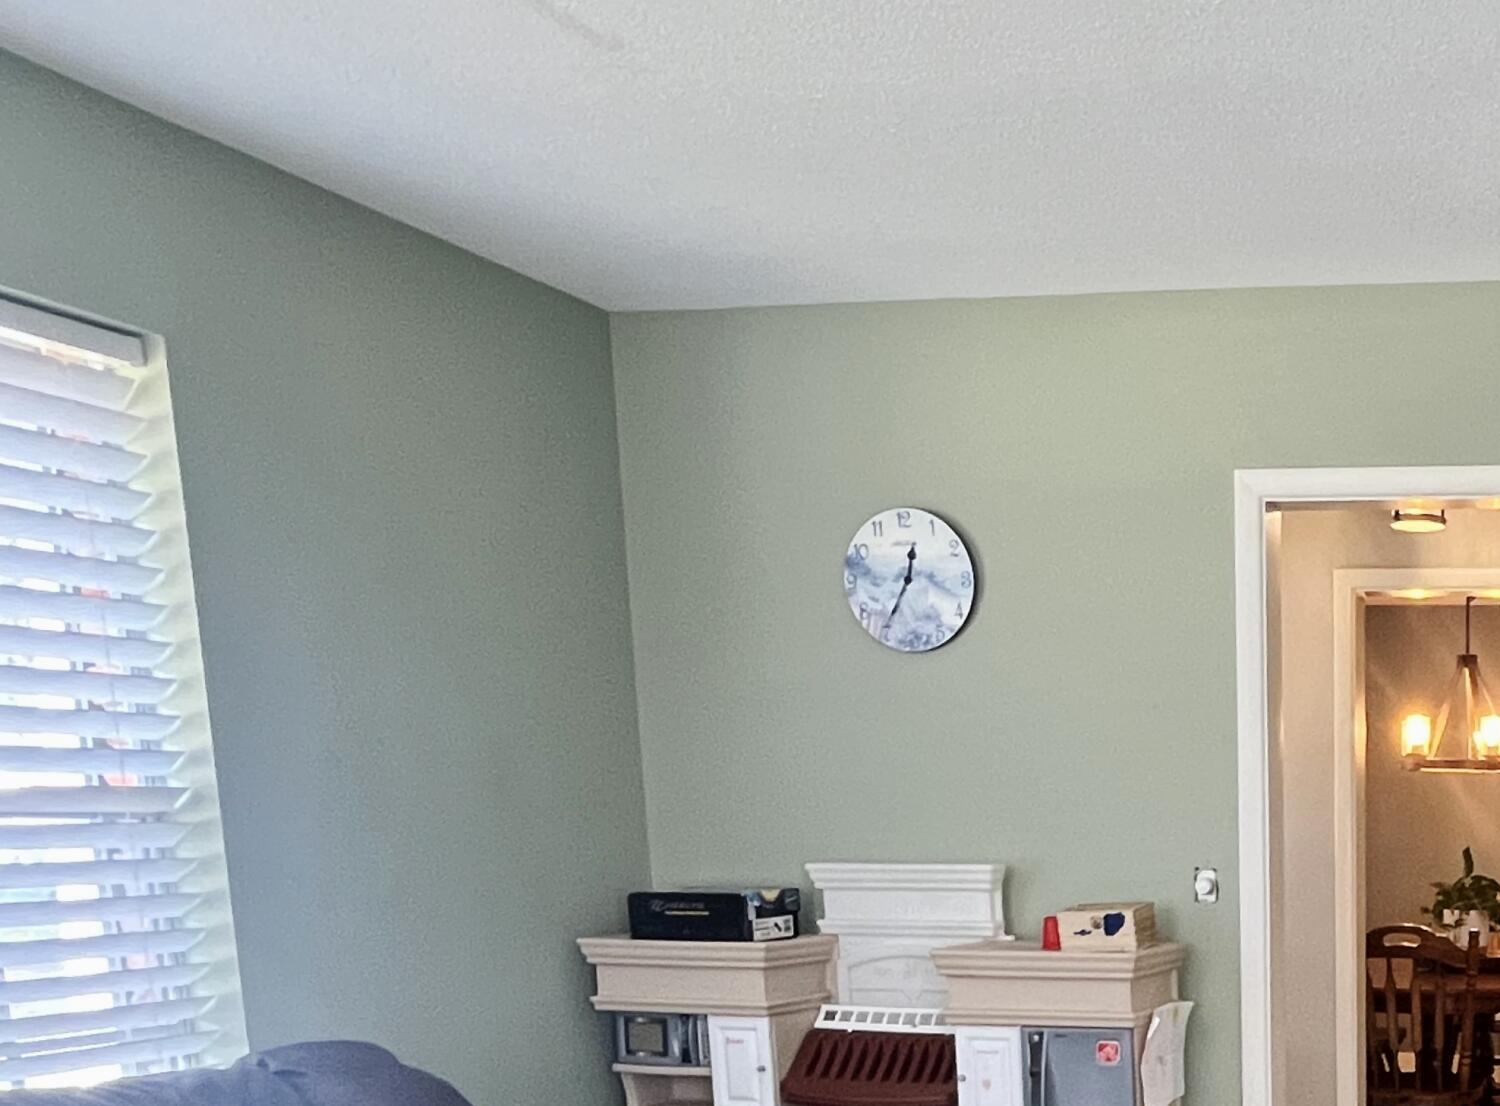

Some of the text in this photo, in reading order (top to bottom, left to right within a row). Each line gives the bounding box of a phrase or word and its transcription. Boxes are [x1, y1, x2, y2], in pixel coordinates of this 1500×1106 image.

[897, 511, 911, 528] 12
[872, 520, 883, 537] 11
[929, 520, 935, 537] 1
[853, 543, 868, 561] 10
[949, 539, 960, 557] 2
[846, 573, 856, 590] 9
[961, 571, 971, 588] 3
[954, 603, 963, 620] 4
